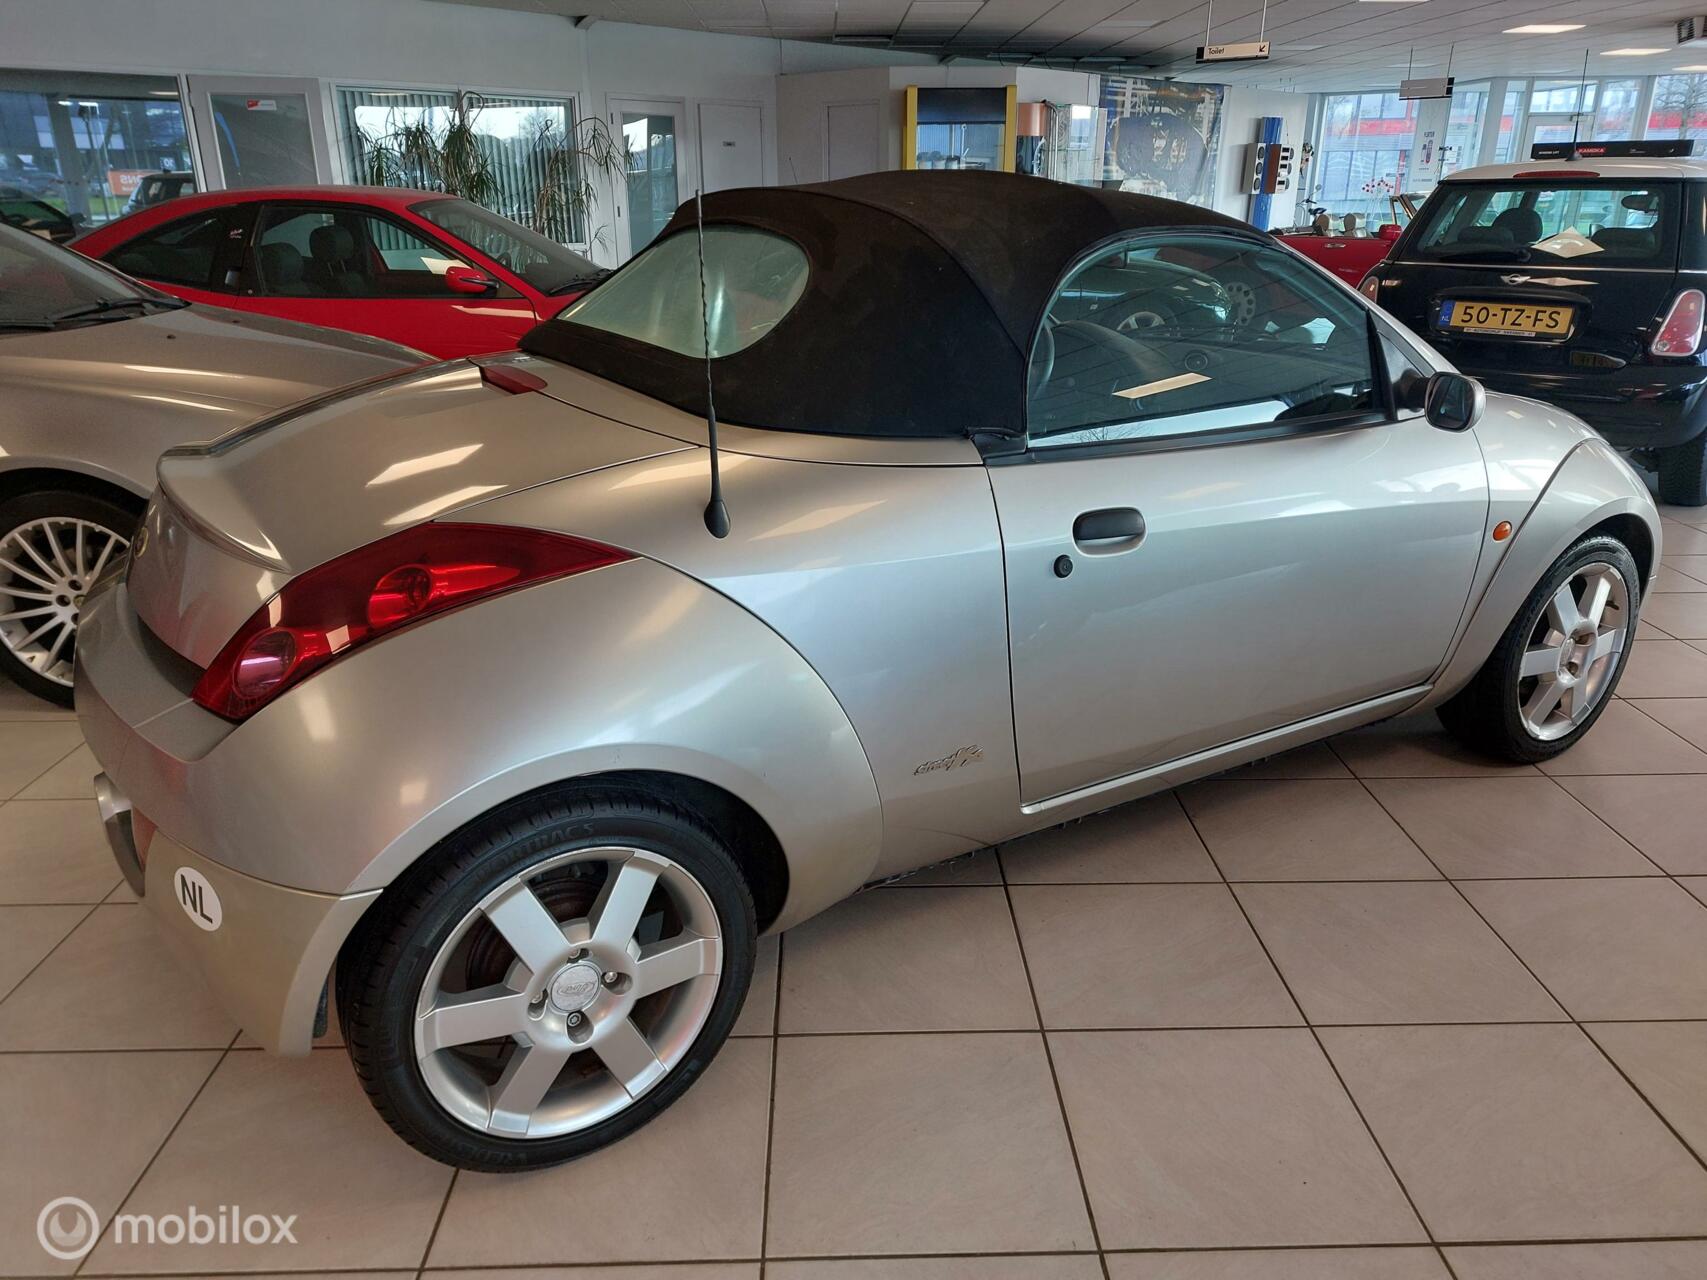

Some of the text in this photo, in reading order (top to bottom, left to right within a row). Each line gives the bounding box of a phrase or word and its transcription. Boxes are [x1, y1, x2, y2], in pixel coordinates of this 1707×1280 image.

[1207, 47, 1225, 55] Toilet
[1461, 305, 1561, 329] 50-TZ-FS
[180, 873, 213, 924] NL
